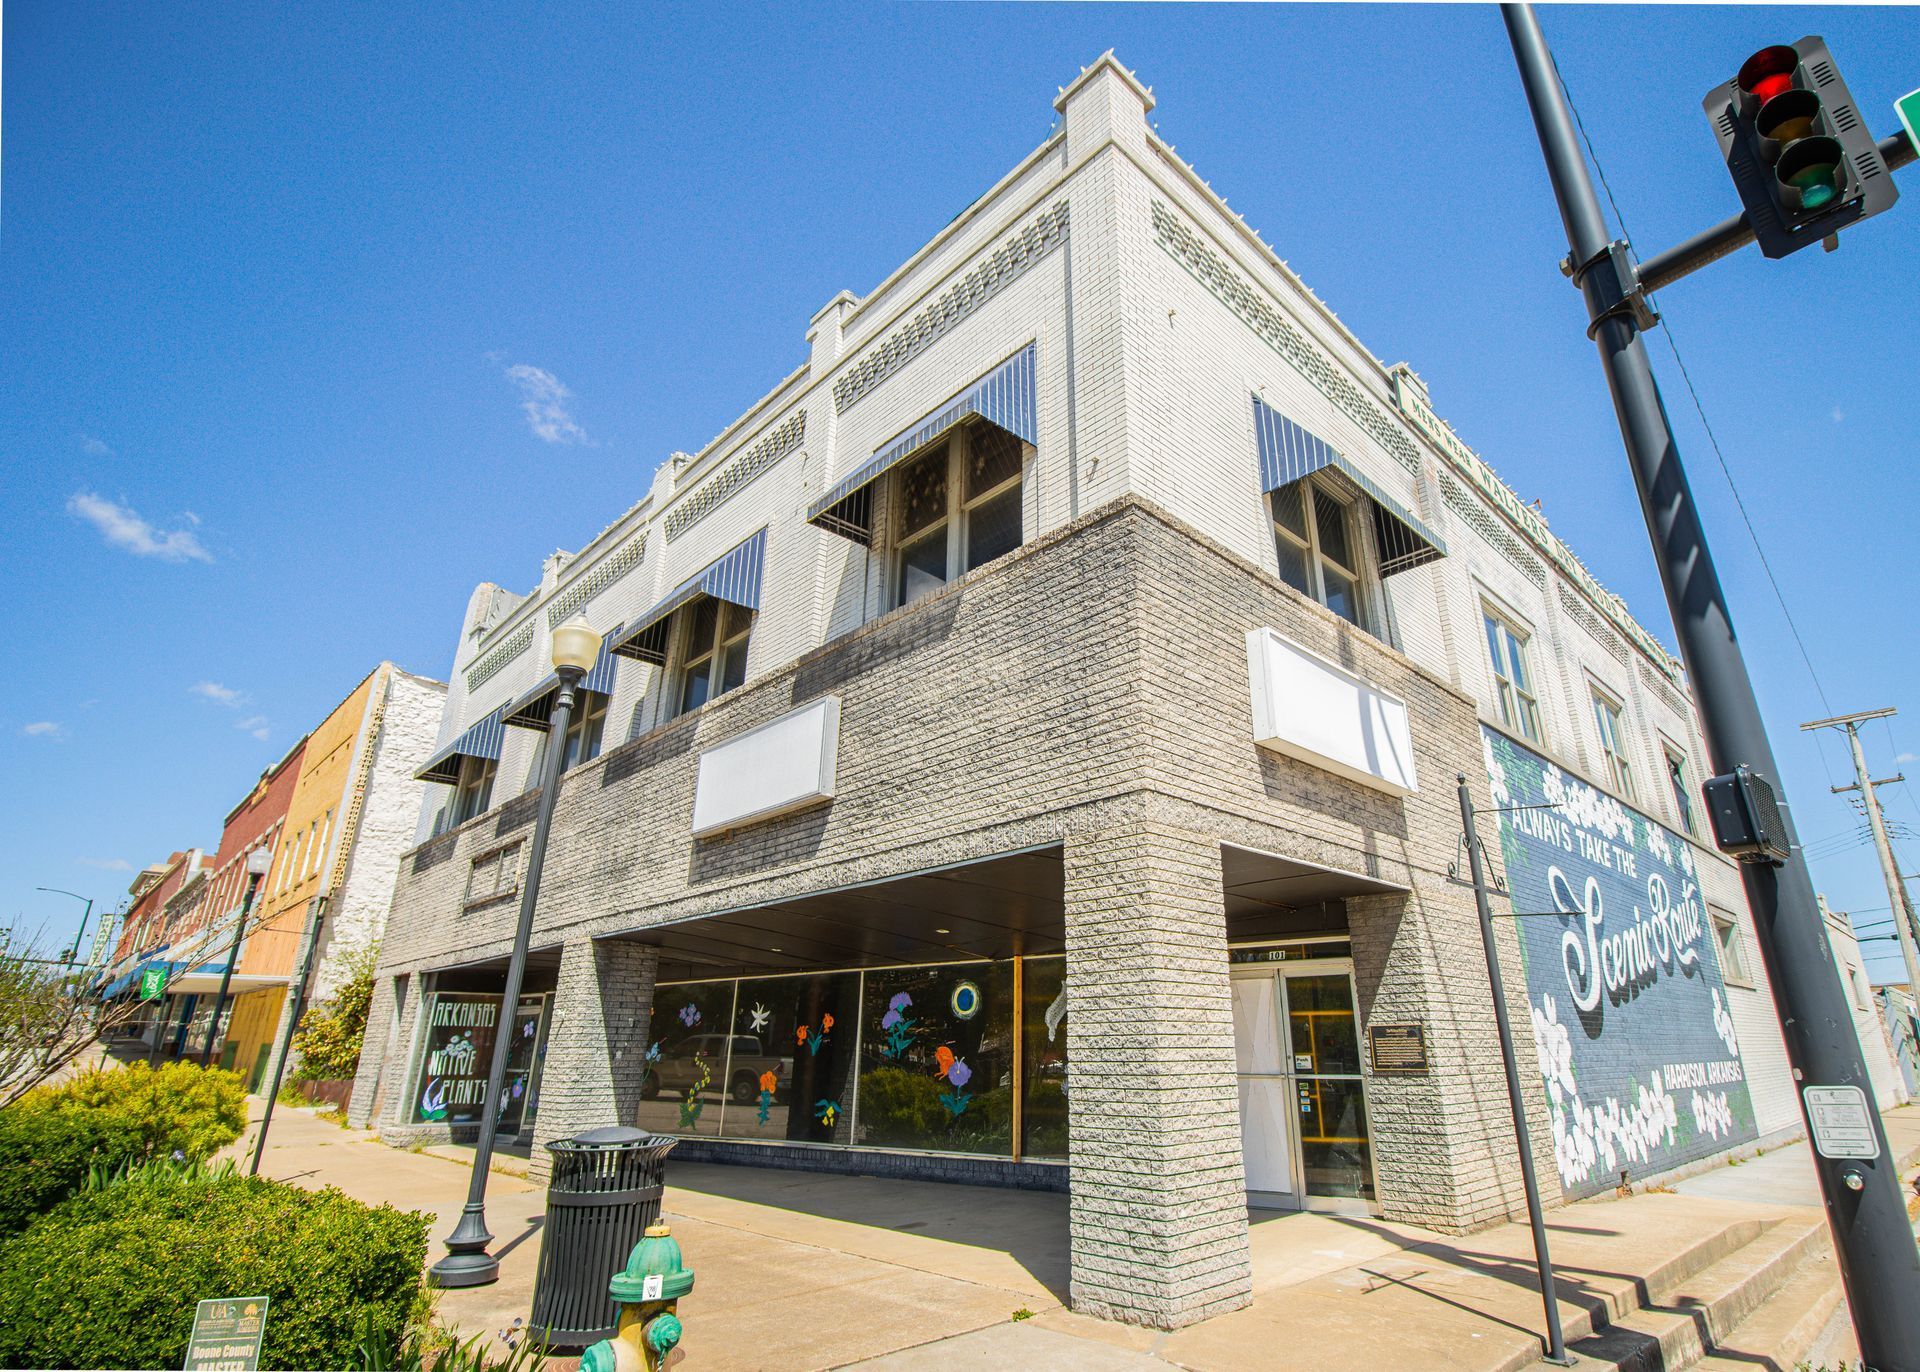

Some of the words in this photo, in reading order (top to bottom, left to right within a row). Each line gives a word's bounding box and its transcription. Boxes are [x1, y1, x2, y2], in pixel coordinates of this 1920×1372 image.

[1443, 431, 1472, 469] WEAR
[1479, 463, 1549, 545] WALTERS
[1553, 540, 1578, 575] DRY
[1511, 798, 1573, 853] ALWAYS
[1575, 828, 1612, 869] TAKE
[1612, 845, 1638, 879] THE
[1547, 865, 1656, 1012] Scenic
[1647, 872, 1702, 966] Route
[1269, 950, 1285, 960] 101
[433, 1002, 497, 1027] ARKANSAS
[1663, 1062, 1709, 1091] HARRISON,
[1707, 1060, 1743, 1085] ARKANSAS
[438, 1080, 488, 1105] PLANTS
[192, 1346, 222, 1360] Boone
[222, 1344, 256, 1358] County
